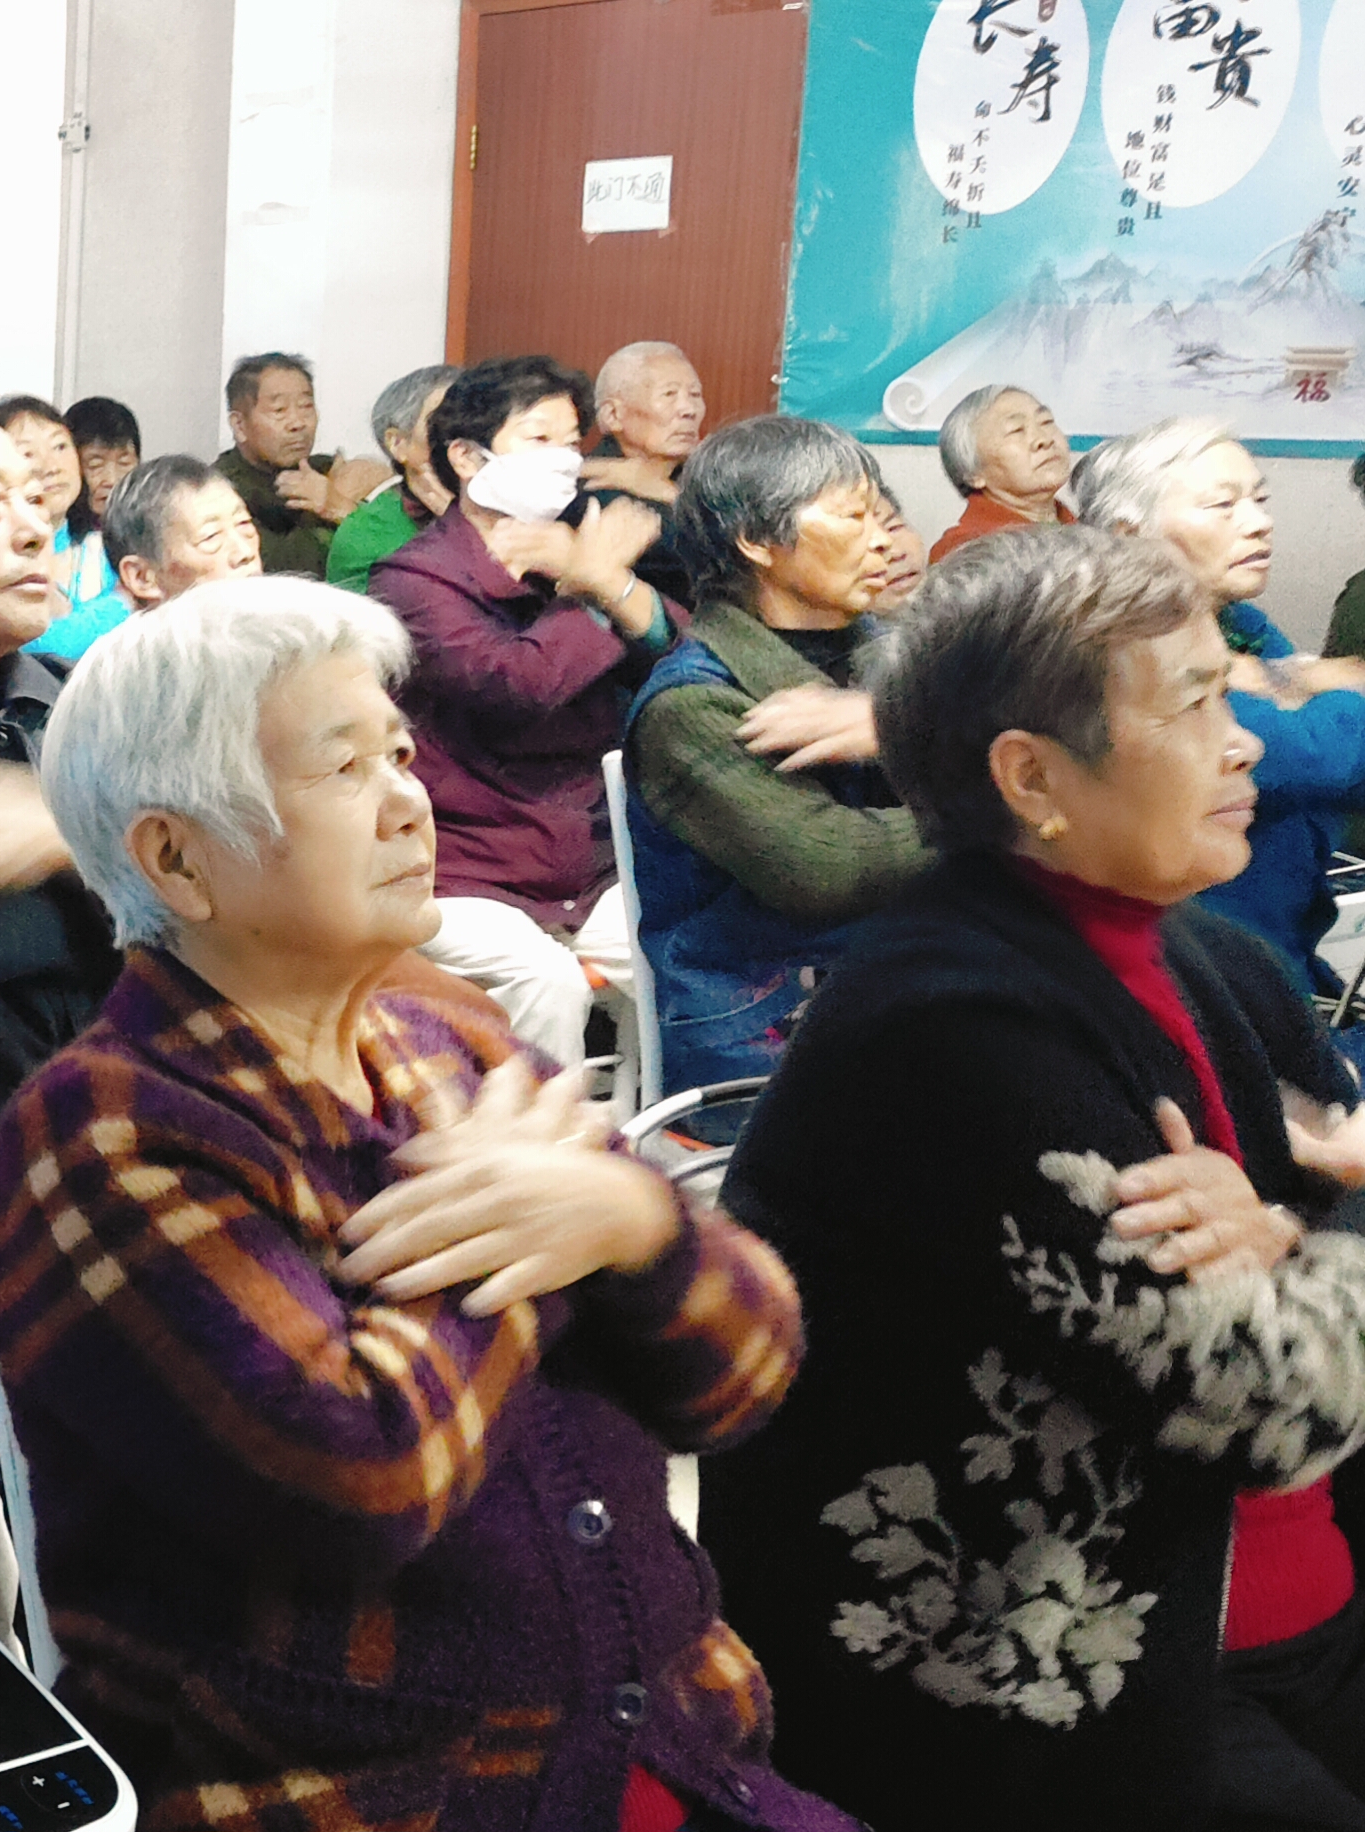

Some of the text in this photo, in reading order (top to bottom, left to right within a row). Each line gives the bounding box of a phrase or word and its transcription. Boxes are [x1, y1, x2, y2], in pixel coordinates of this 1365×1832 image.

[967, 0, 1062, 124] 长寿
[586, 171, 666, 204] 此门不通
[941, 143, 966, 244] 福寿绵长
[1115, 129, 1145, 237] 地位尊贵
[1144, 83, 1177, 220] 钱财富足且
[1293, 371, 1331, 403] 福
